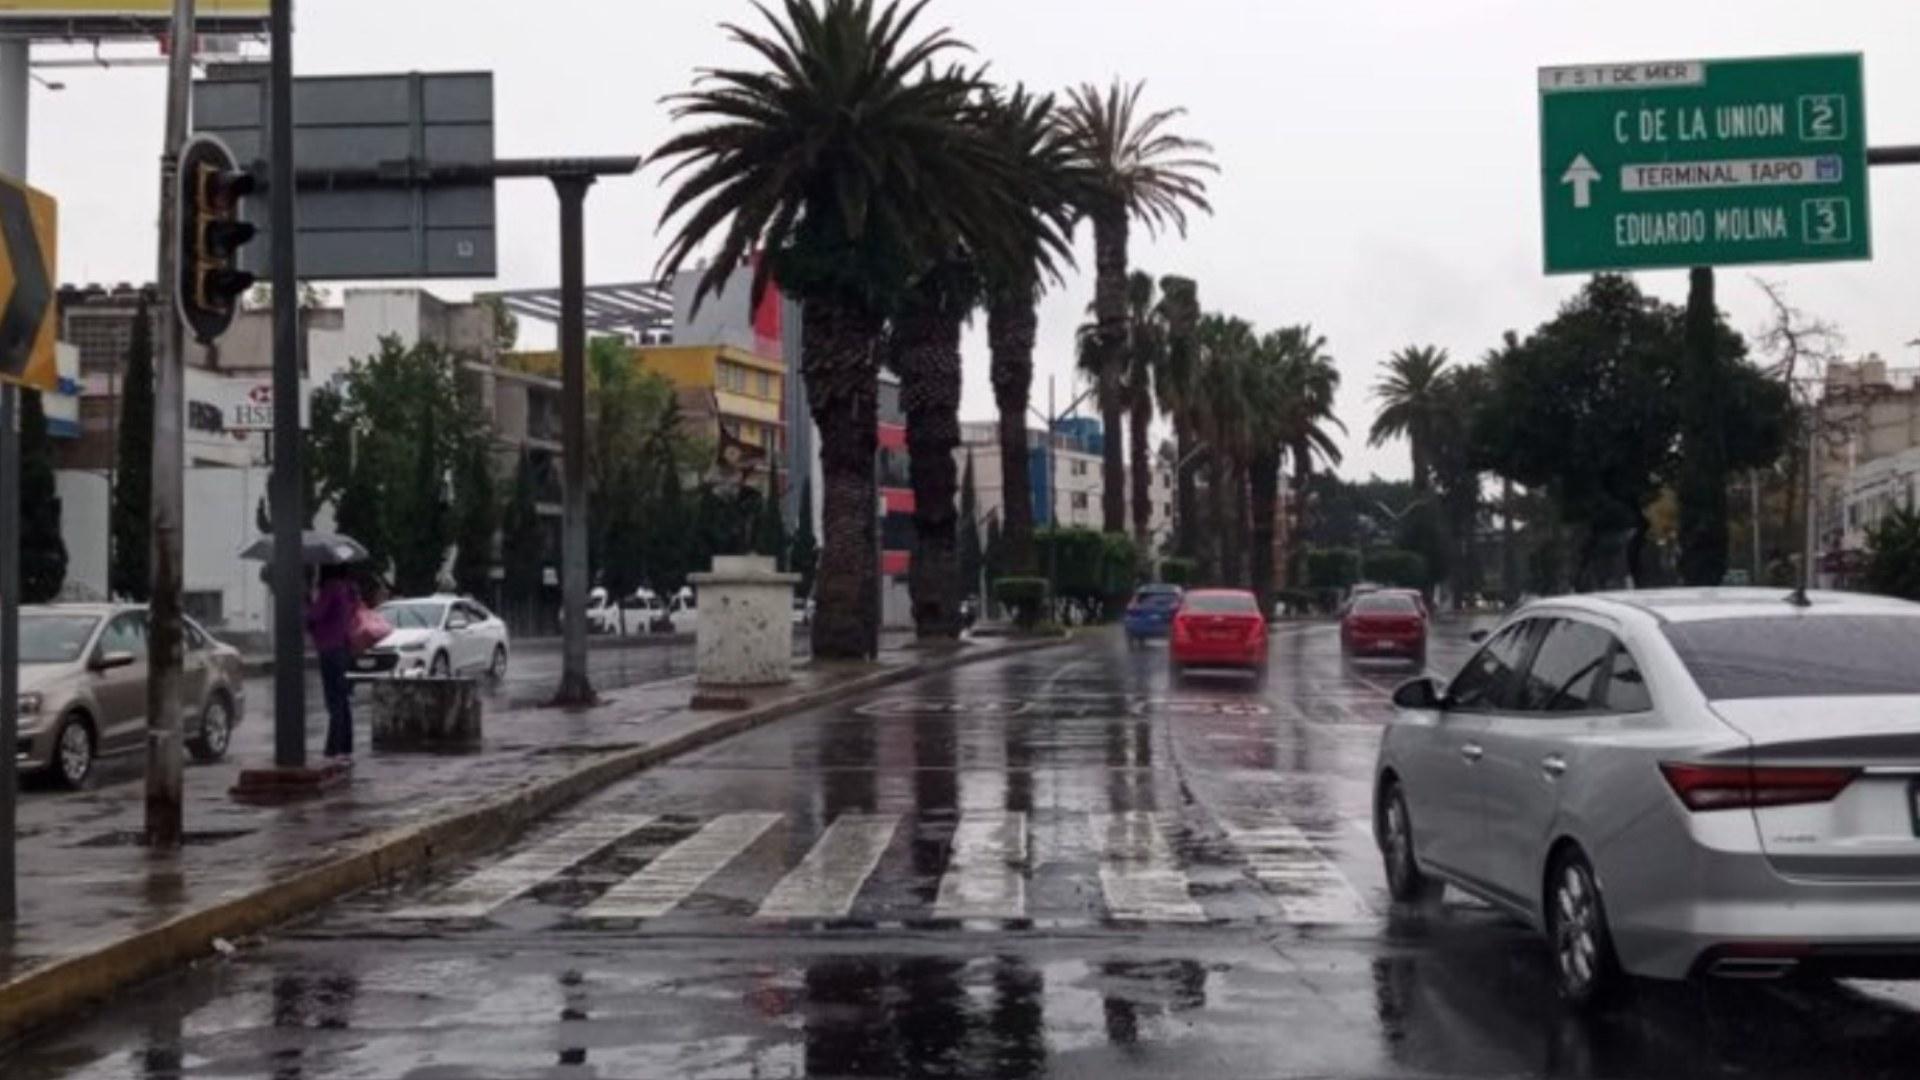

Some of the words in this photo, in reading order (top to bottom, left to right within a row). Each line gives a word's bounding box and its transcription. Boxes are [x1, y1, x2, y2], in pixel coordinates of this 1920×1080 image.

[1613, 66, 1637, 83] DE
[1614, 110, 1630, 144] C
[1639, 107, 1666, 142] DE
[1677, 106, 1707, 141] LA
[1717, 103, 1785, 139] UNION
[1811, 104, 1833, 131] 2
[1635, 164, 1739, 187] TERMINAL
[1750, 160, 1802, 181] TAPO
[1615, 210, 1706, 247] EDUARDO
[1715, 206, 1787, 242] MOLINA
[1815, 207, 1837, 235] 3
